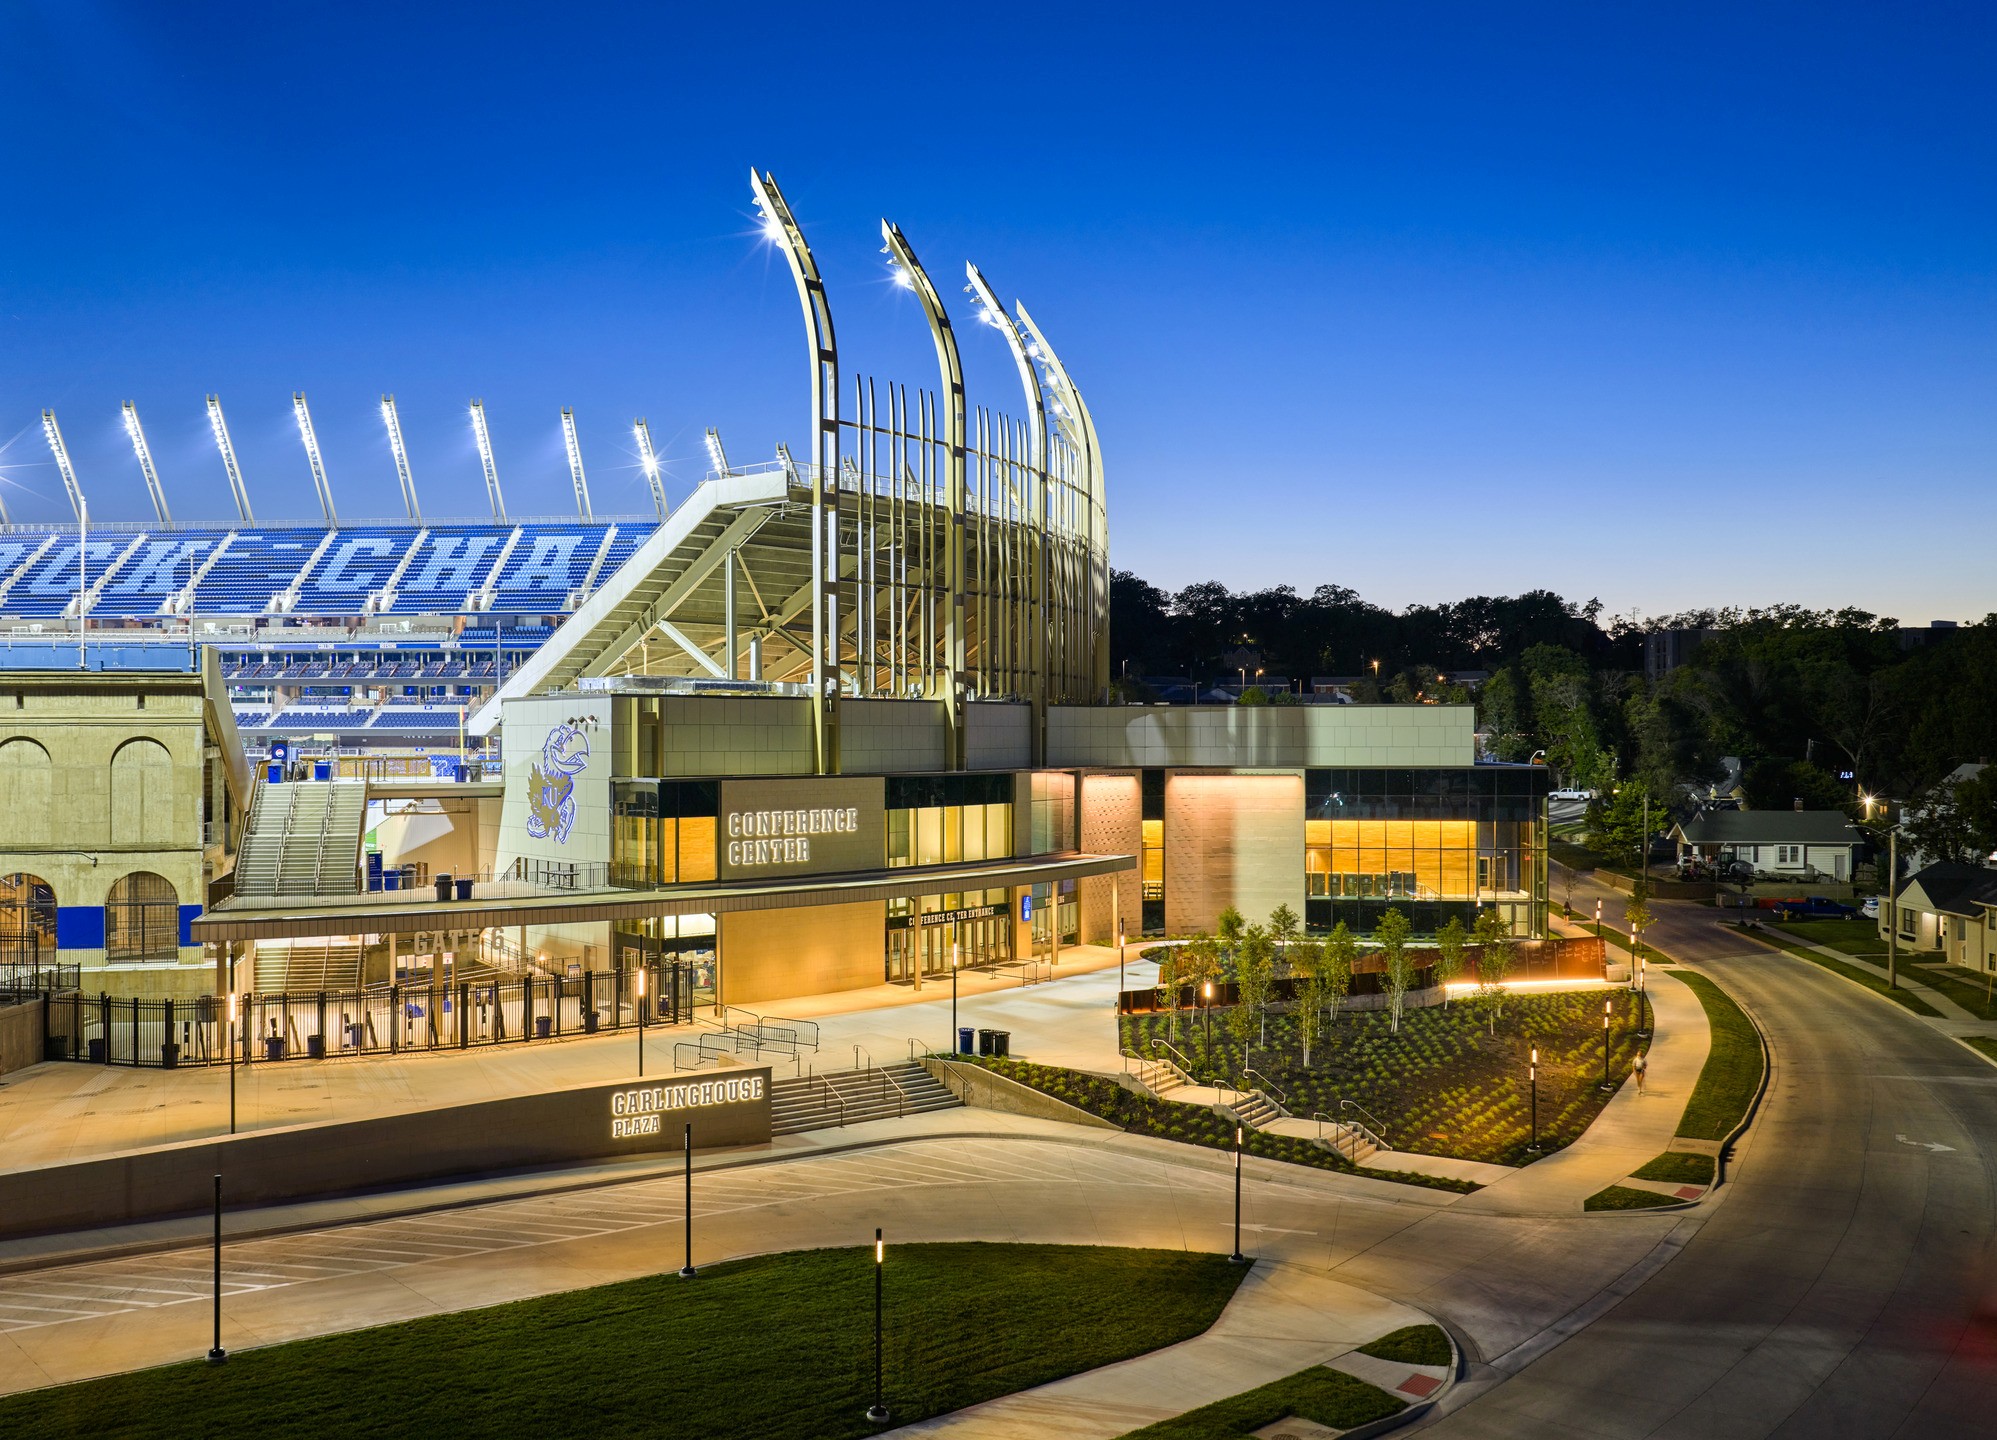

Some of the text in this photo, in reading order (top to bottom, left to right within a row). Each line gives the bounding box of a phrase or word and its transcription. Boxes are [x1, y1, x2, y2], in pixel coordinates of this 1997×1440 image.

[314, 535, 651, 592] CHA
[542, 786, 558, 809] KU
[729, 808, 858, 837] CONFERENCE
[729, 838, 810, 866] CENTER
[908, 906, 994, 926] CFERENCE CETER ENTRANCE
[414, 927, 505, 954] GATE 6
[613, 1078, 763, 1115] GARLINGHOUSE
[613, 1116, 660, 1137] PLAZA
